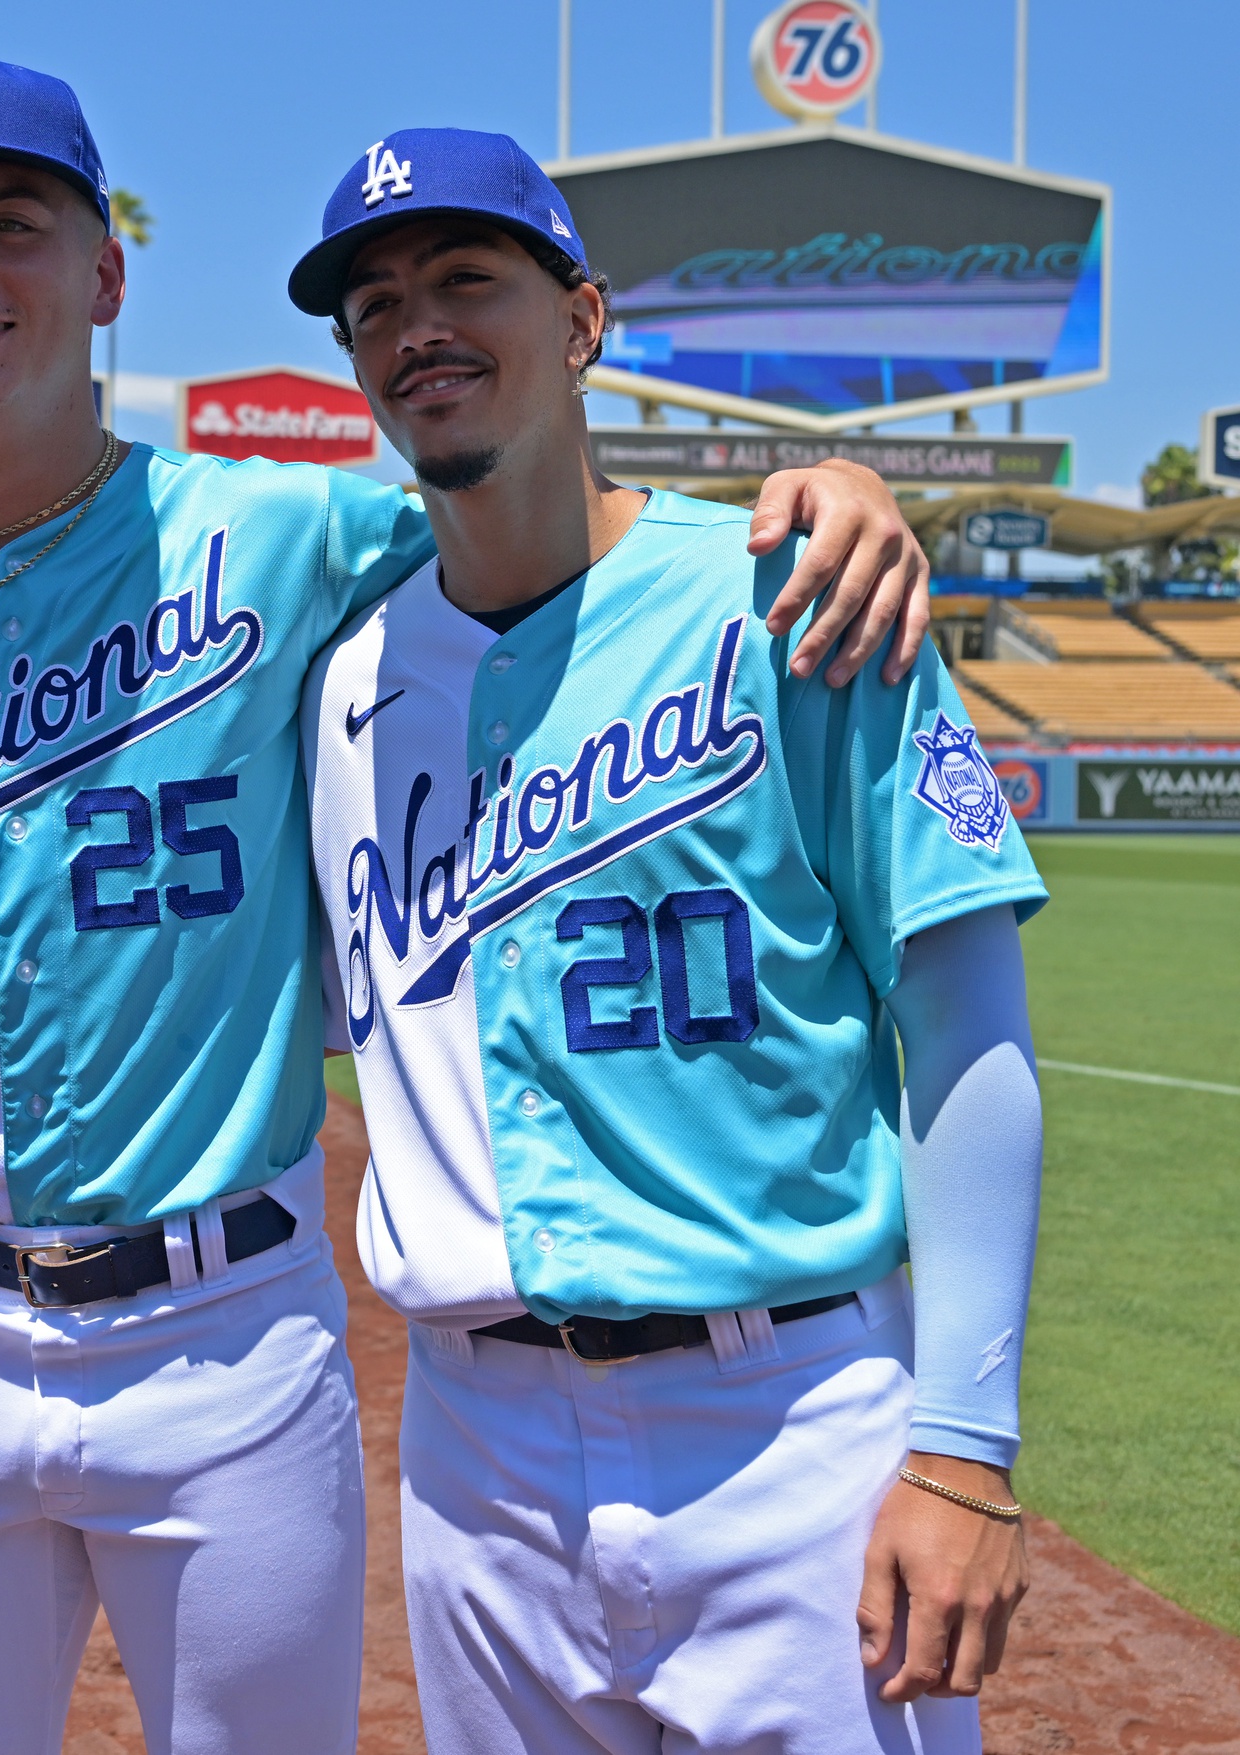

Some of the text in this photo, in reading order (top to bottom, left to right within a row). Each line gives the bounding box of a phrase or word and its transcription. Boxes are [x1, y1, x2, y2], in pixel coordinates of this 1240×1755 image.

[785, 18, 865, 82] 76
[361, 140, 413, 206] LA
[926, 444, 995, 477] GAME
[943, 764, 983, 793] NATIONAL
[64, 773, 246, 932] 25
[347, 612, 769, 1052] National
[556, 887, 760, 1053] 20
